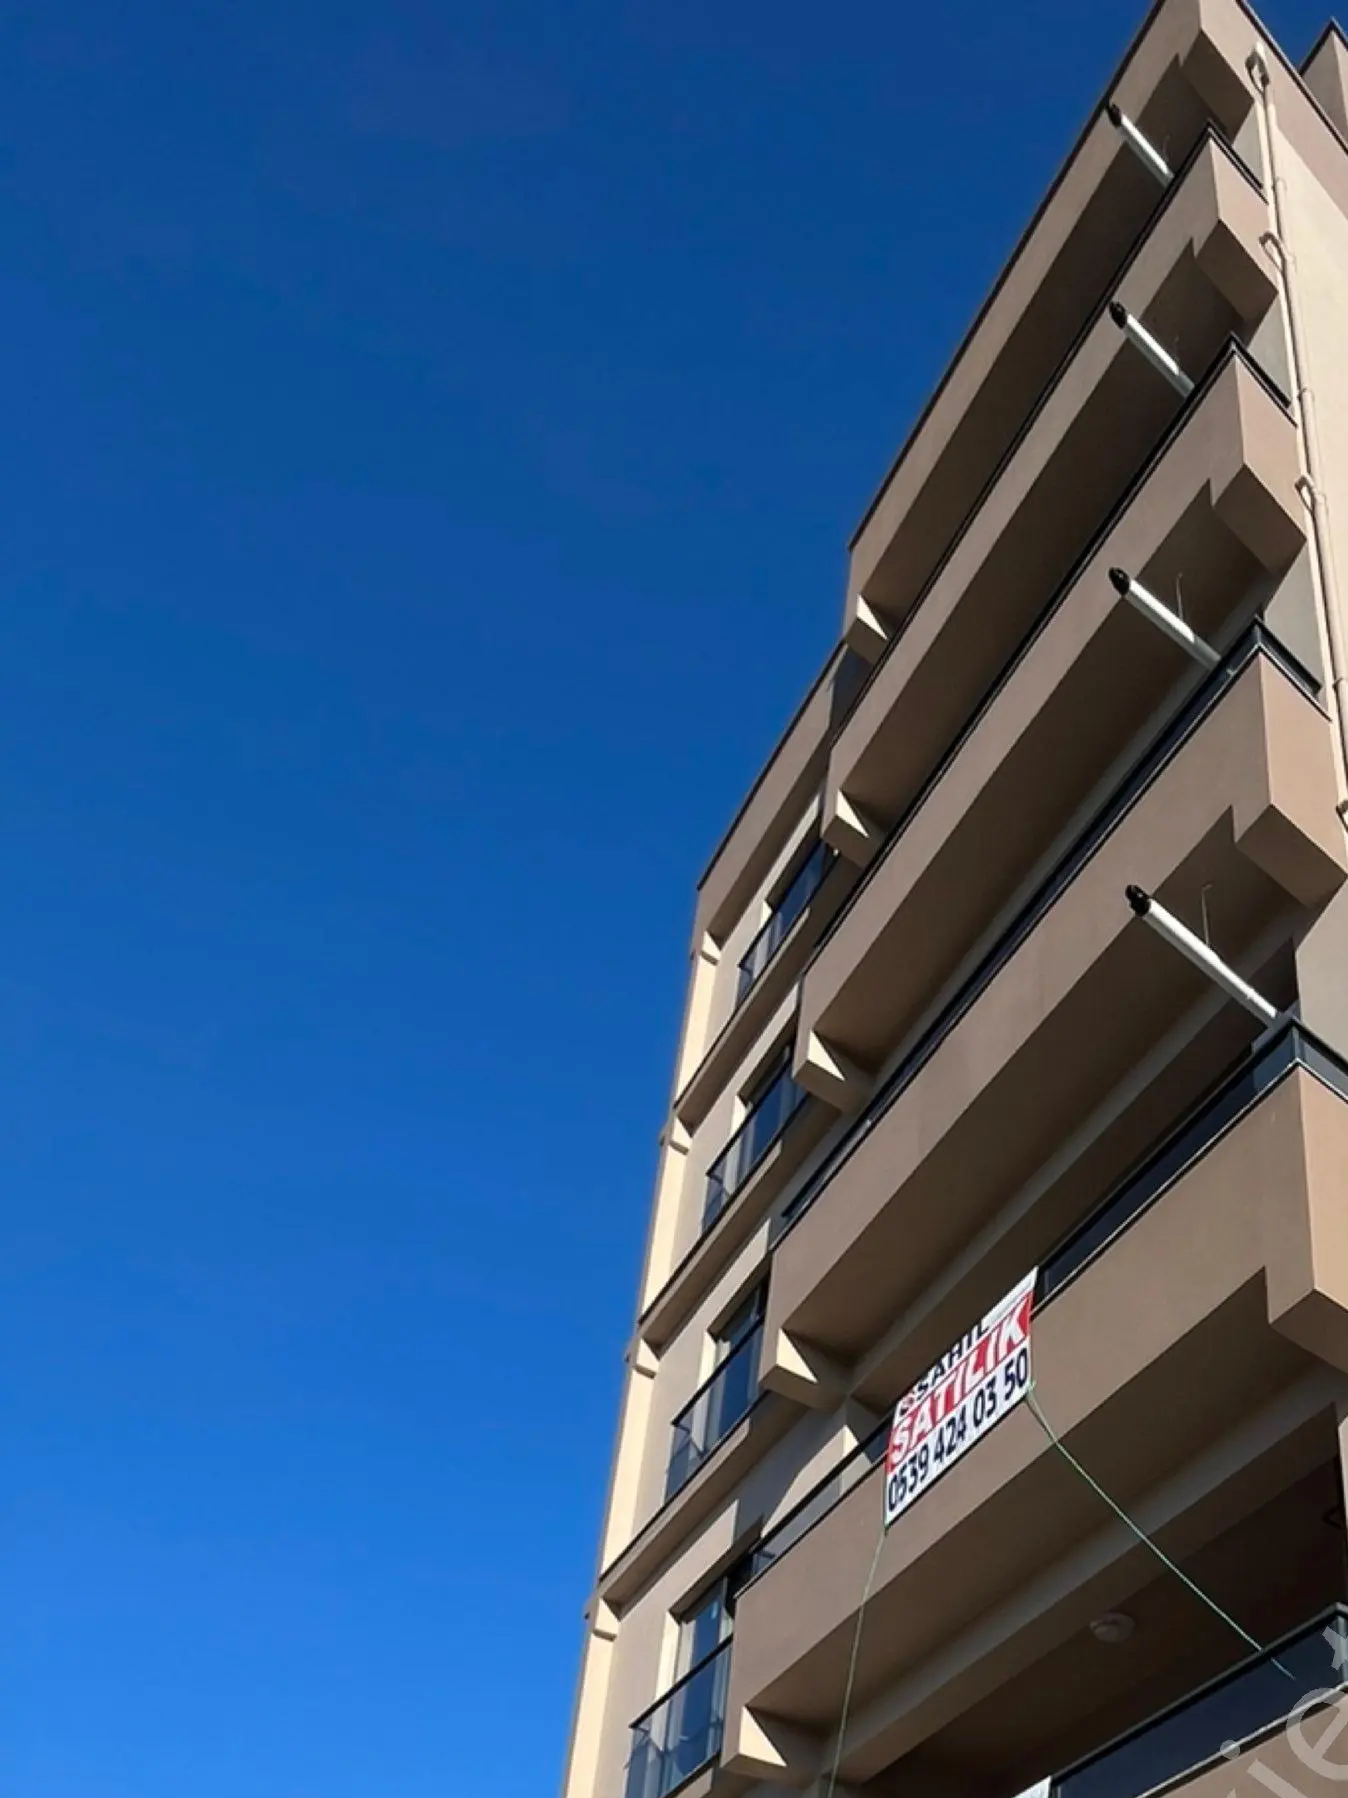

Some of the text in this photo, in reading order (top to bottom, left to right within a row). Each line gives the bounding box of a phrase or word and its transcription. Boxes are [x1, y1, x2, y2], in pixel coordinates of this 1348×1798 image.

[888, 1347, 1029, 1513] 0539 424 03 50
[891, 1297, 1029, 1465] SATILIK
